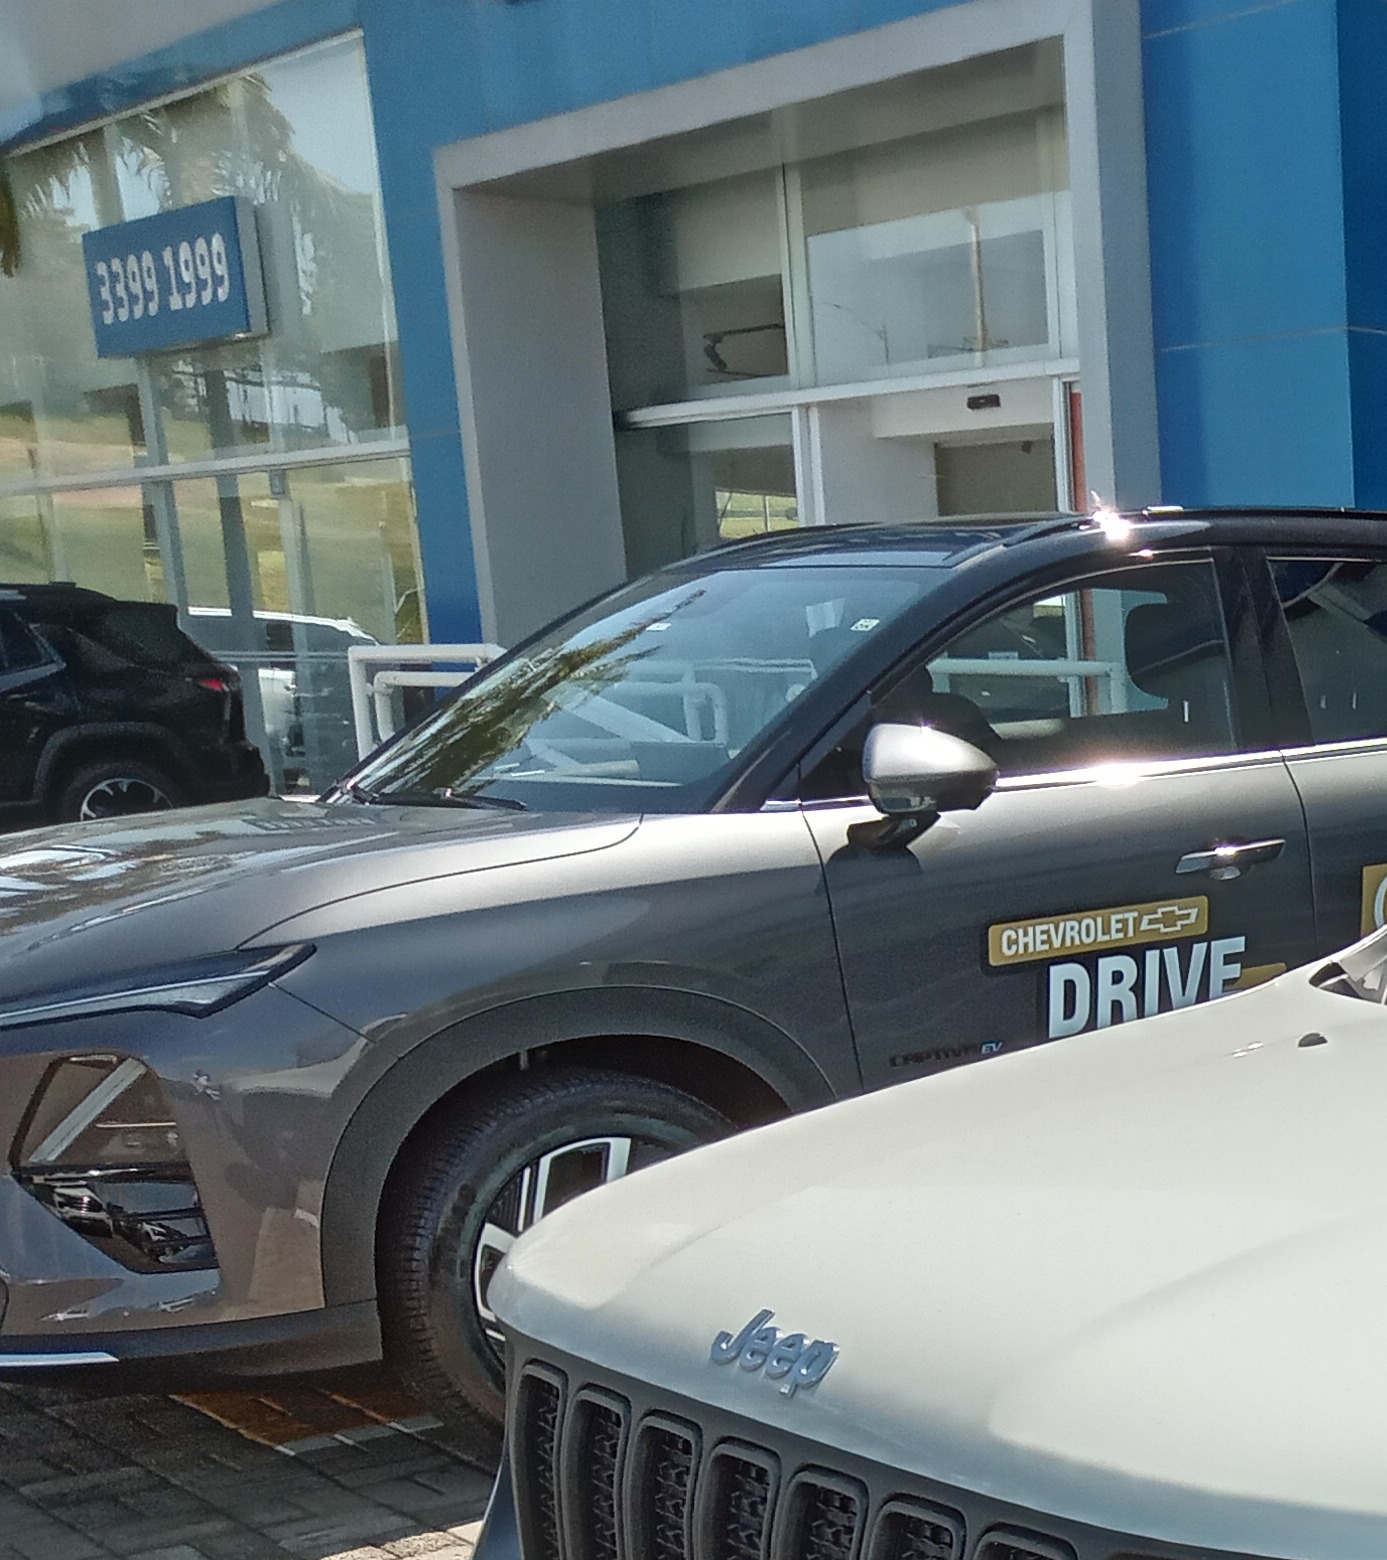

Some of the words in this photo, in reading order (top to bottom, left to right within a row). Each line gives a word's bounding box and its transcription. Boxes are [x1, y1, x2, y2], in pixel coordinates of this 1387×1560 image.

[95, 250, 160, 325] 3399
[163, 232, 229, 311] 1999
[1001, 911, 1139, 957] CHEVROLET
[1049, 936, 1246, 1039] DRIVE
[981, 1042, 1003, 1054] EV
[711, 1307, 840, 1398] Jeep
